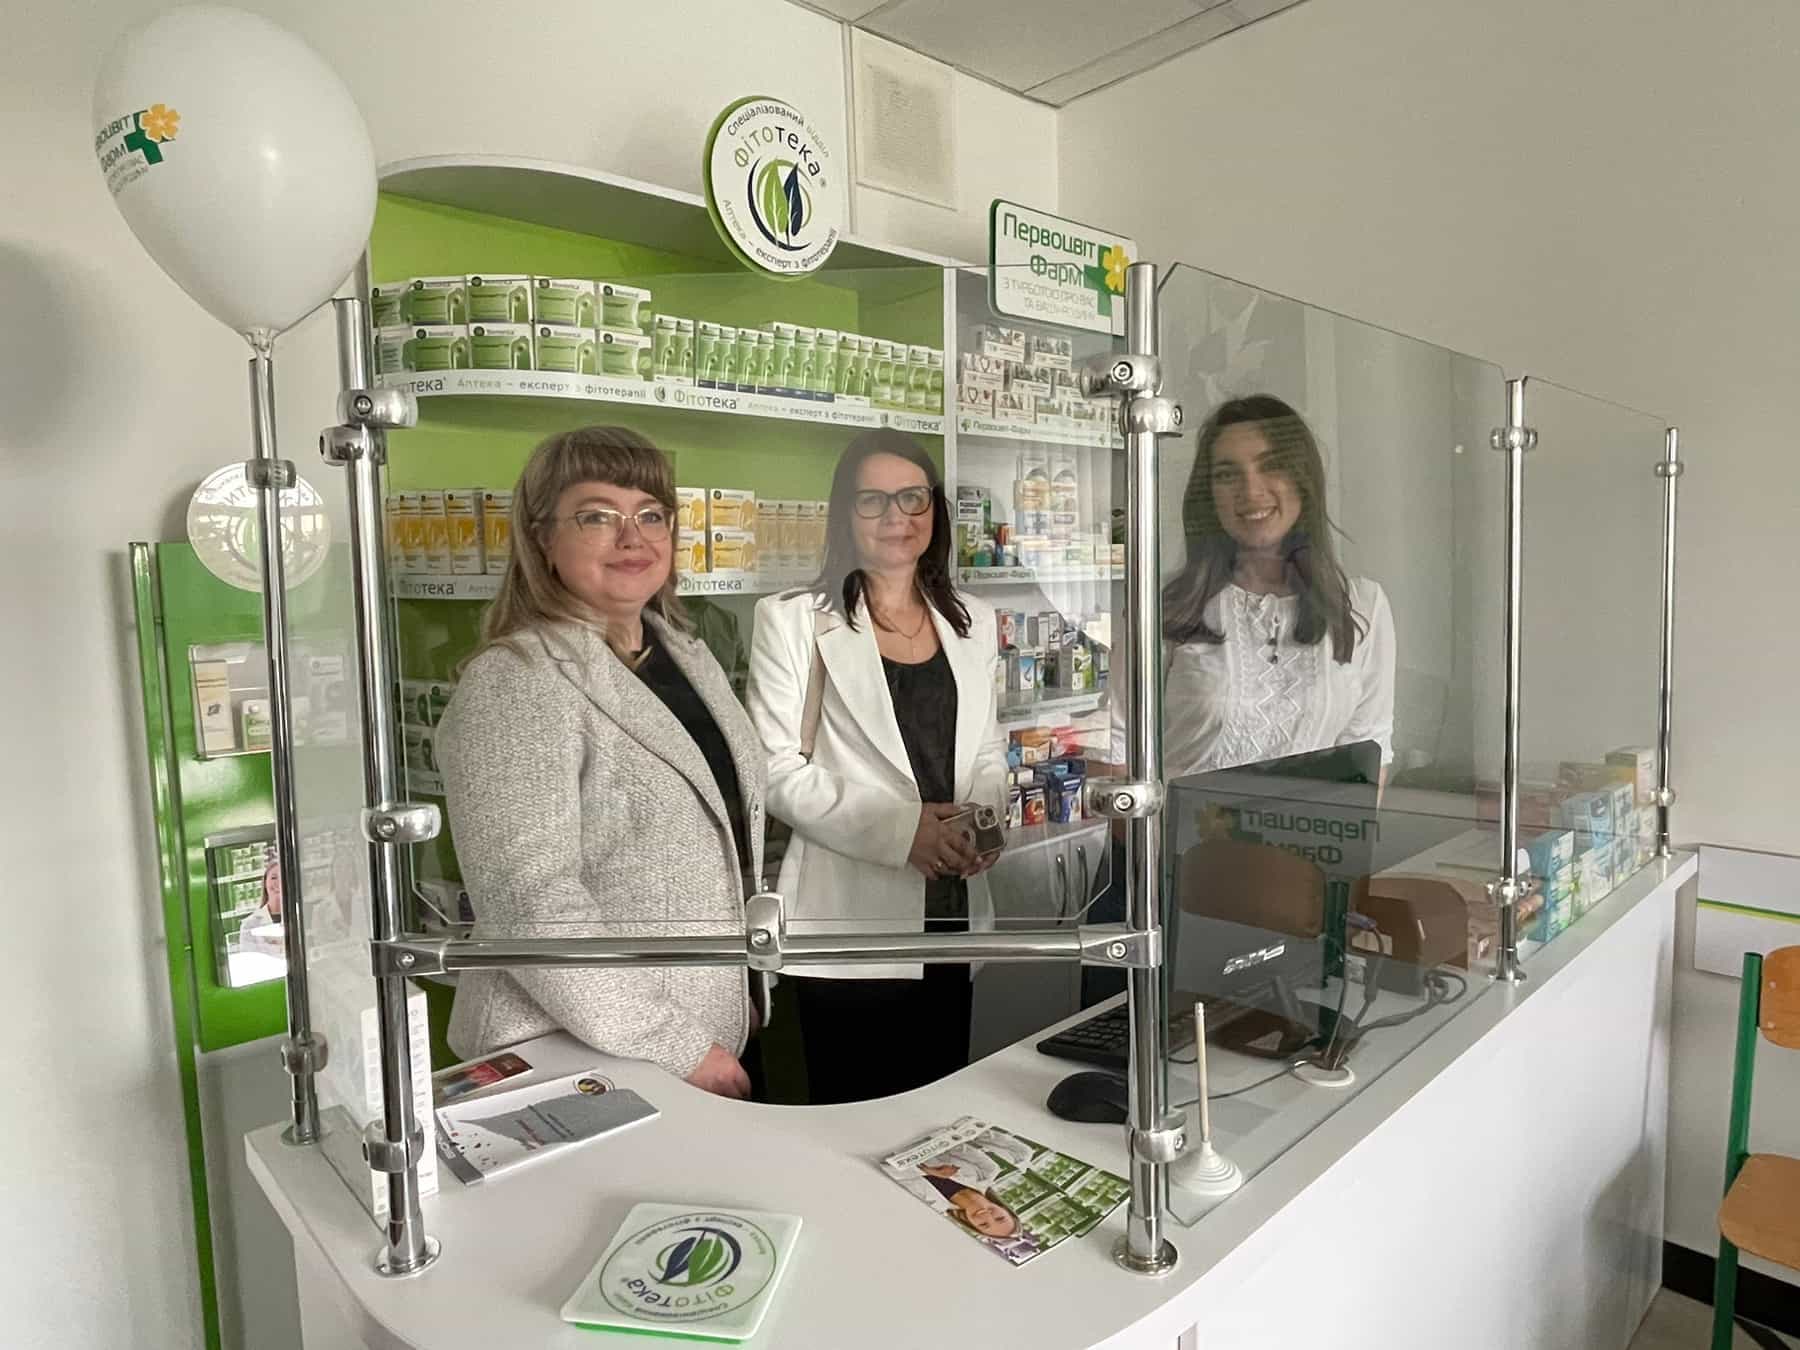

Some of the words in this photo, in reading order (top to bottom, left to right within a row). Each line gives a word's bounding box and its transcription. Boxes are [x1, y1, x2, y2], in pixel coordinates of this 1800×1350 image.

[734, 126, 820, 176] Фітотека
[1003, 212, 1096, 259] Первоцвіт
[1030, 254, 1084, 287] Фарм
[519, 380, 569, 393] експерт
[585, 383, 646, 399] фітотерапії
[673, 389, 737, 410] Фітотека
[894, 415, 940, 431] Фітотека
[680, 577, 742, 591] Фітотека
[627, 1278, 735, 1308] Фітотека
